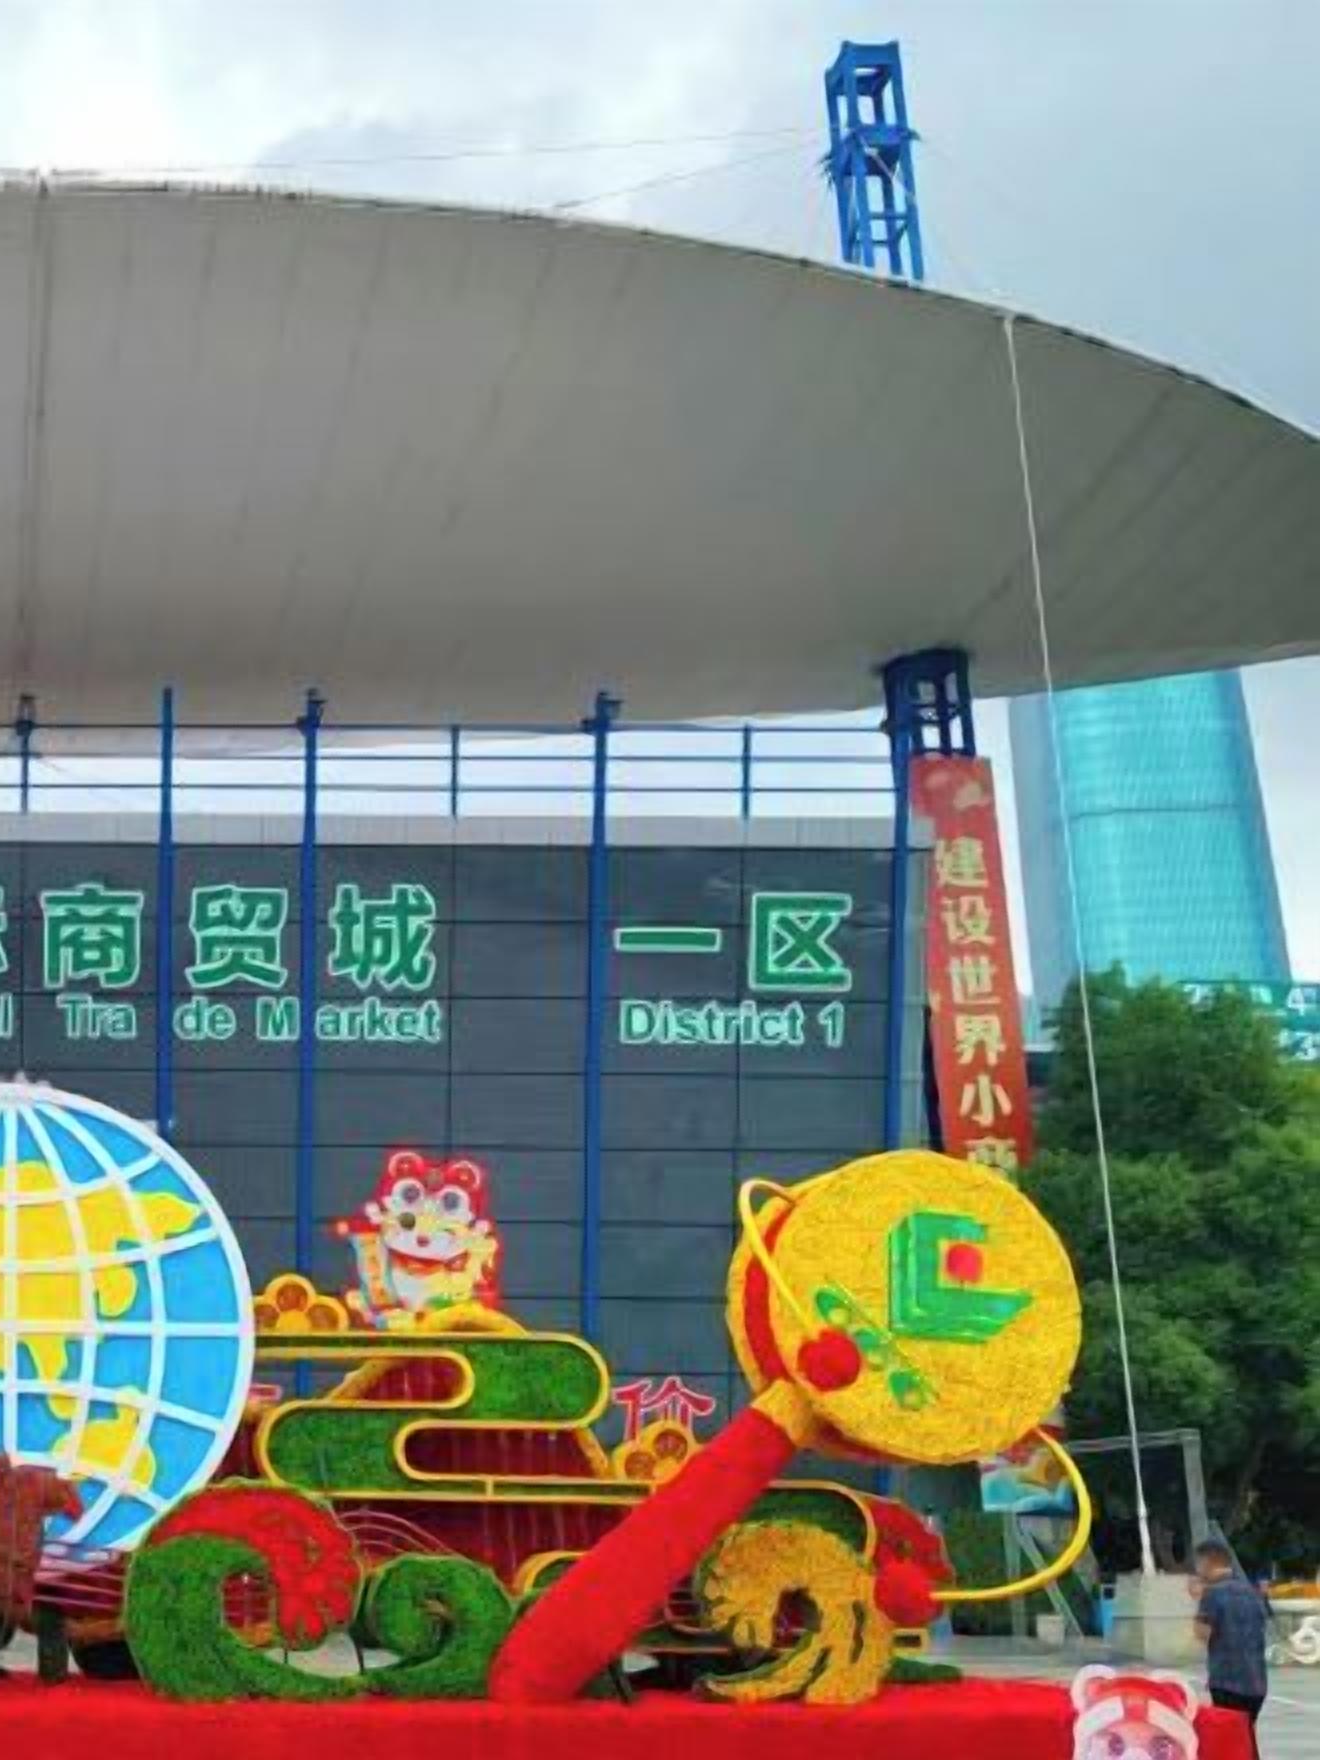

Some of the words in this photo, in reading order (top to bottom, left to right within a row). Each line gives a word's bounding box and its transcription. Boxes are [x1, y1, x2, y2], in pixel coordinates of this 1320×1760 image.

[614, 892, 852, 991] 一区
[620, 1000, 804, 1045] District
[817, 1001, 845, 1046] 1
